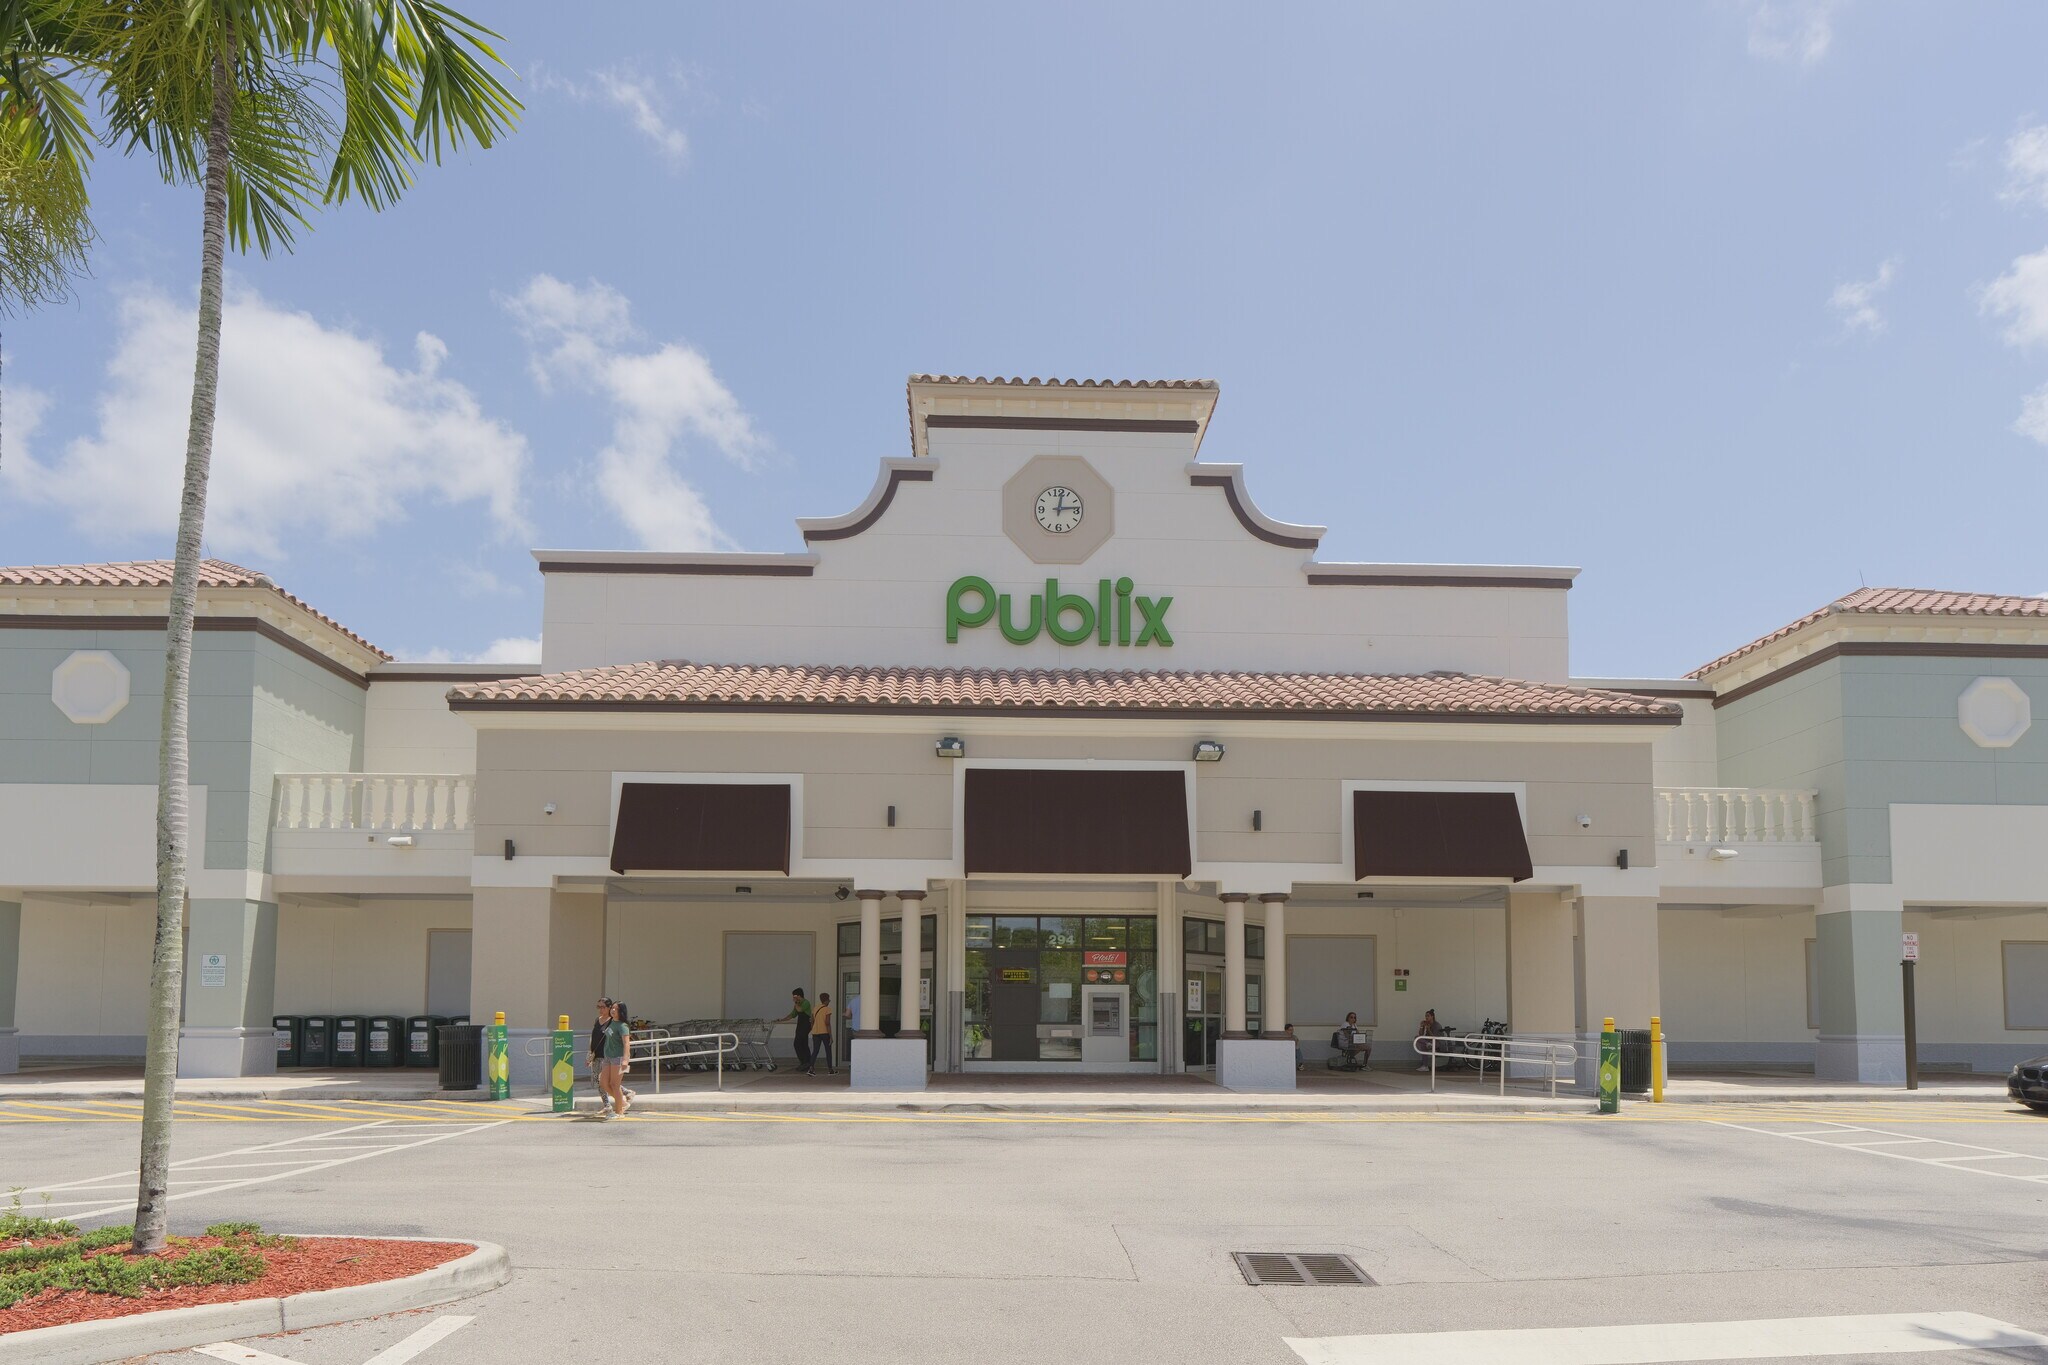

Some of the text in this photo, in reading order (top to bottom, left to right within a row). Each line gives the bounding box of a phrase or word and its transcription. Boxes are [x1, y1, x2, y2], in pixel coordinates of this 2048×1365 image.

[1053, 488, 1065, 497] 12
[1038, 506, 1045, 514] 9
[1073, 506, 1080, 515] 3
[1055, 523, 1062, 532] 6
[946, 575, 1174, 647] Publix
[1049, 934, 1075, 945] 294
